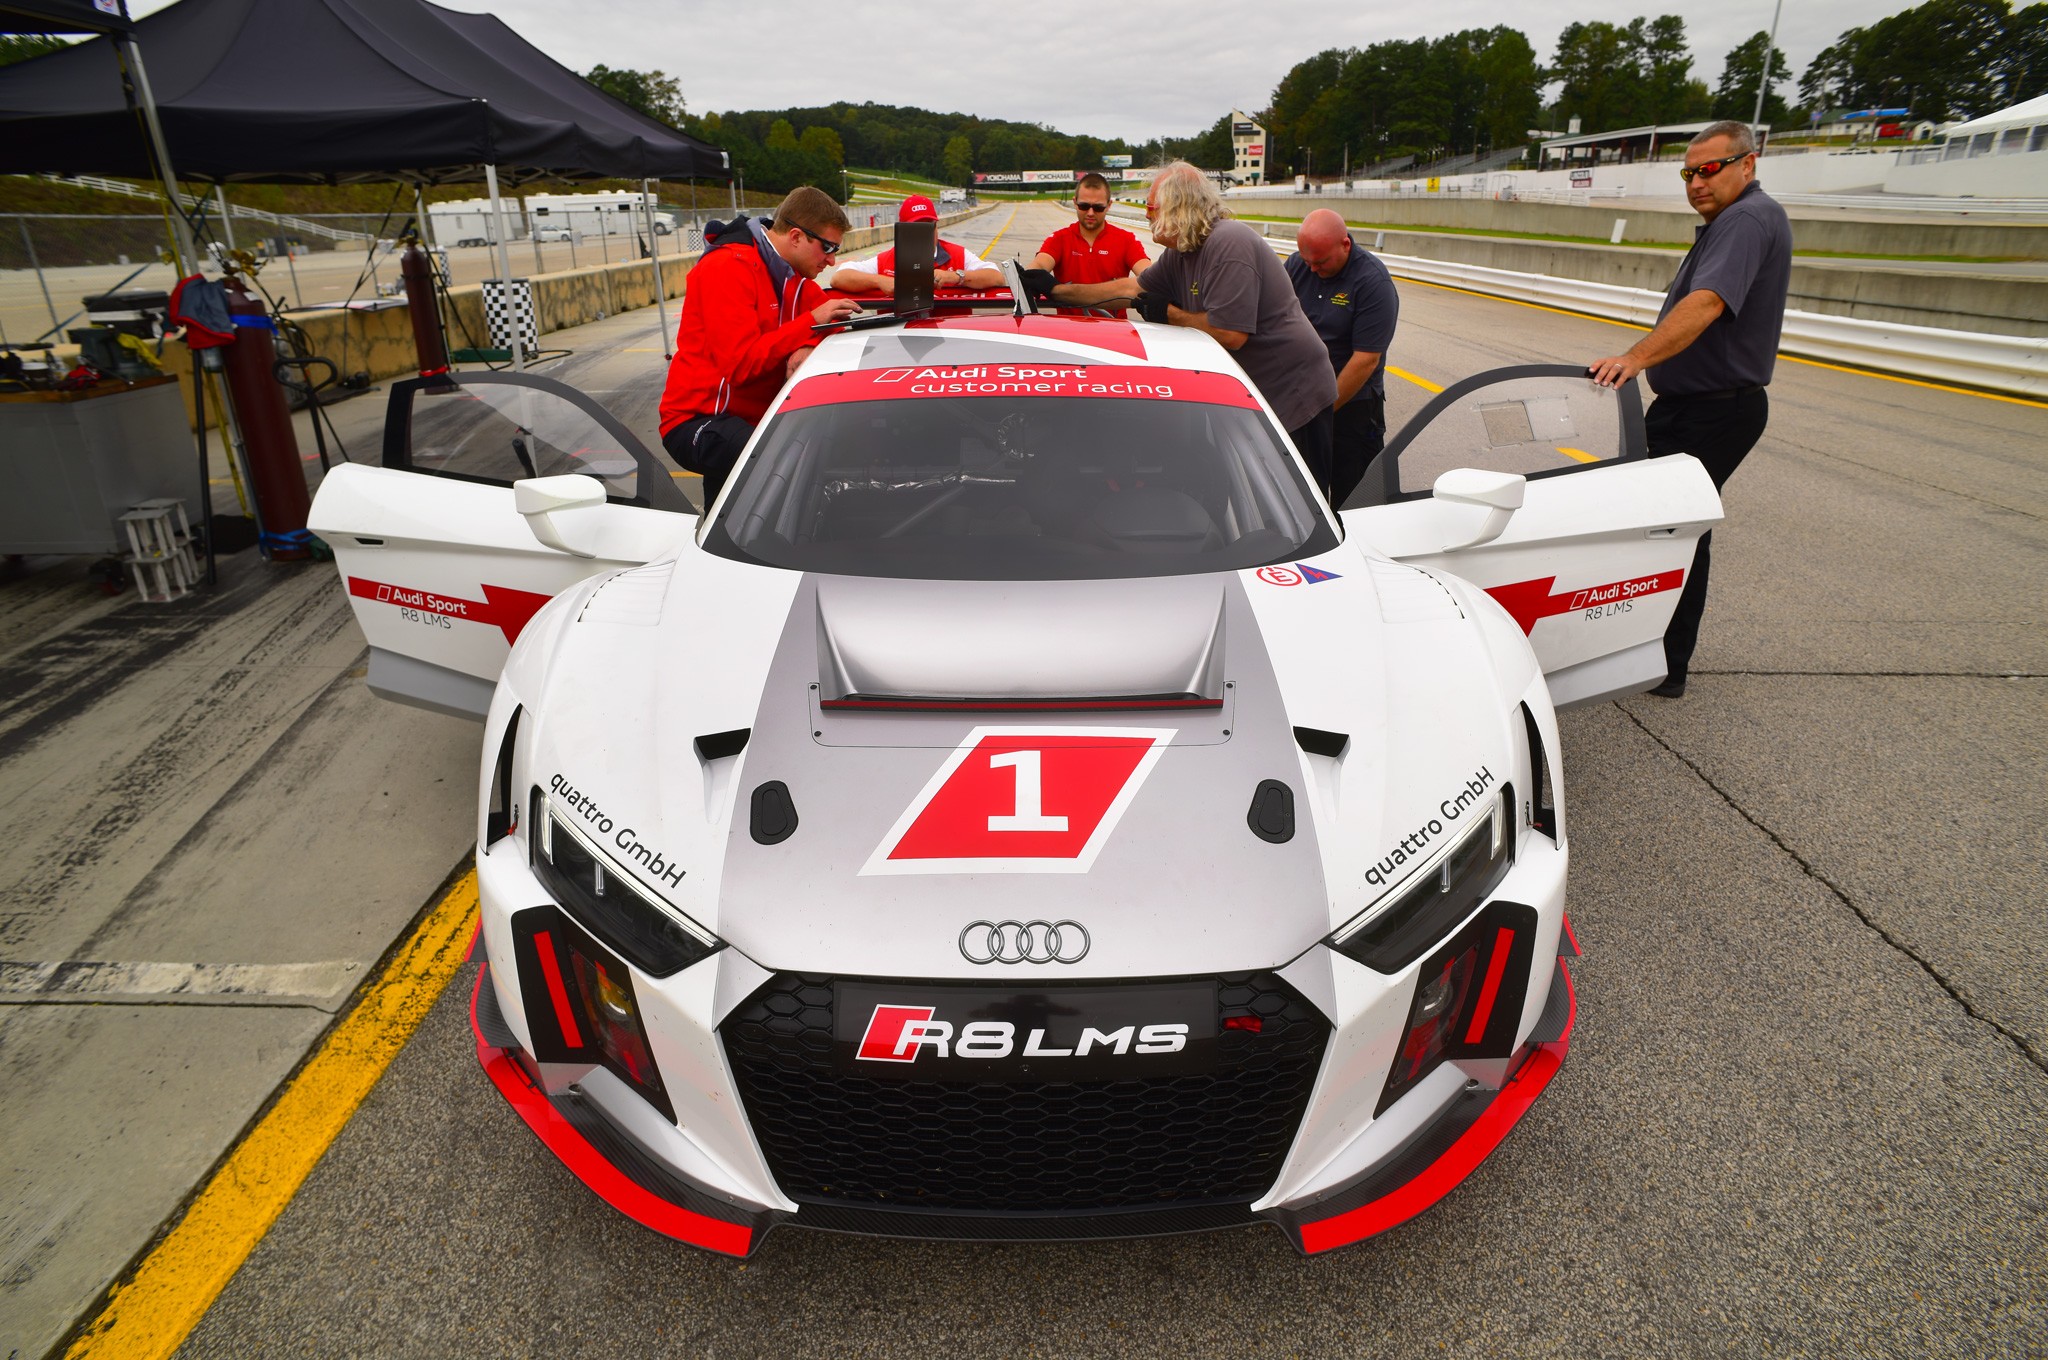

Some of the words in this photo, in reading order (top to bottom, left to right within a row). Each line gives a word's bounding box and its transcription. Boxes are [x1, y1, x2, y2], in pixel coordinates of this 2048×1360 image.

[915, 366, 987, 380] Audi
[997, 366, 1087, 380] Sport
[910, 381, 1067, 394] customer
[1077, 381, 1174, 397] racing
[393, 588, 424, 607] Audi
[426, 594, 468, 615] Sport
[1588, 584, 1620, 603] Audi
[1622, 577, 1659, 598] Sport
[401, 607, 420, 622] R8
[422, 612, 452, 630] LMS
[1584, 606, 1603, 621] R8
[1606, 600, 1634, 617] LMS
[987, 750, 1069, 832] 1
[550, 773, 614, 834] quattro
[615, 828, 687, 889] GmbH
[1364, 819, 1443, 886] quattro
[1440, 765, 1495, 821] GmbH
[892, 1019, 1016, 1059] R8
[1022, 1022, 1190, 1057] LMS
